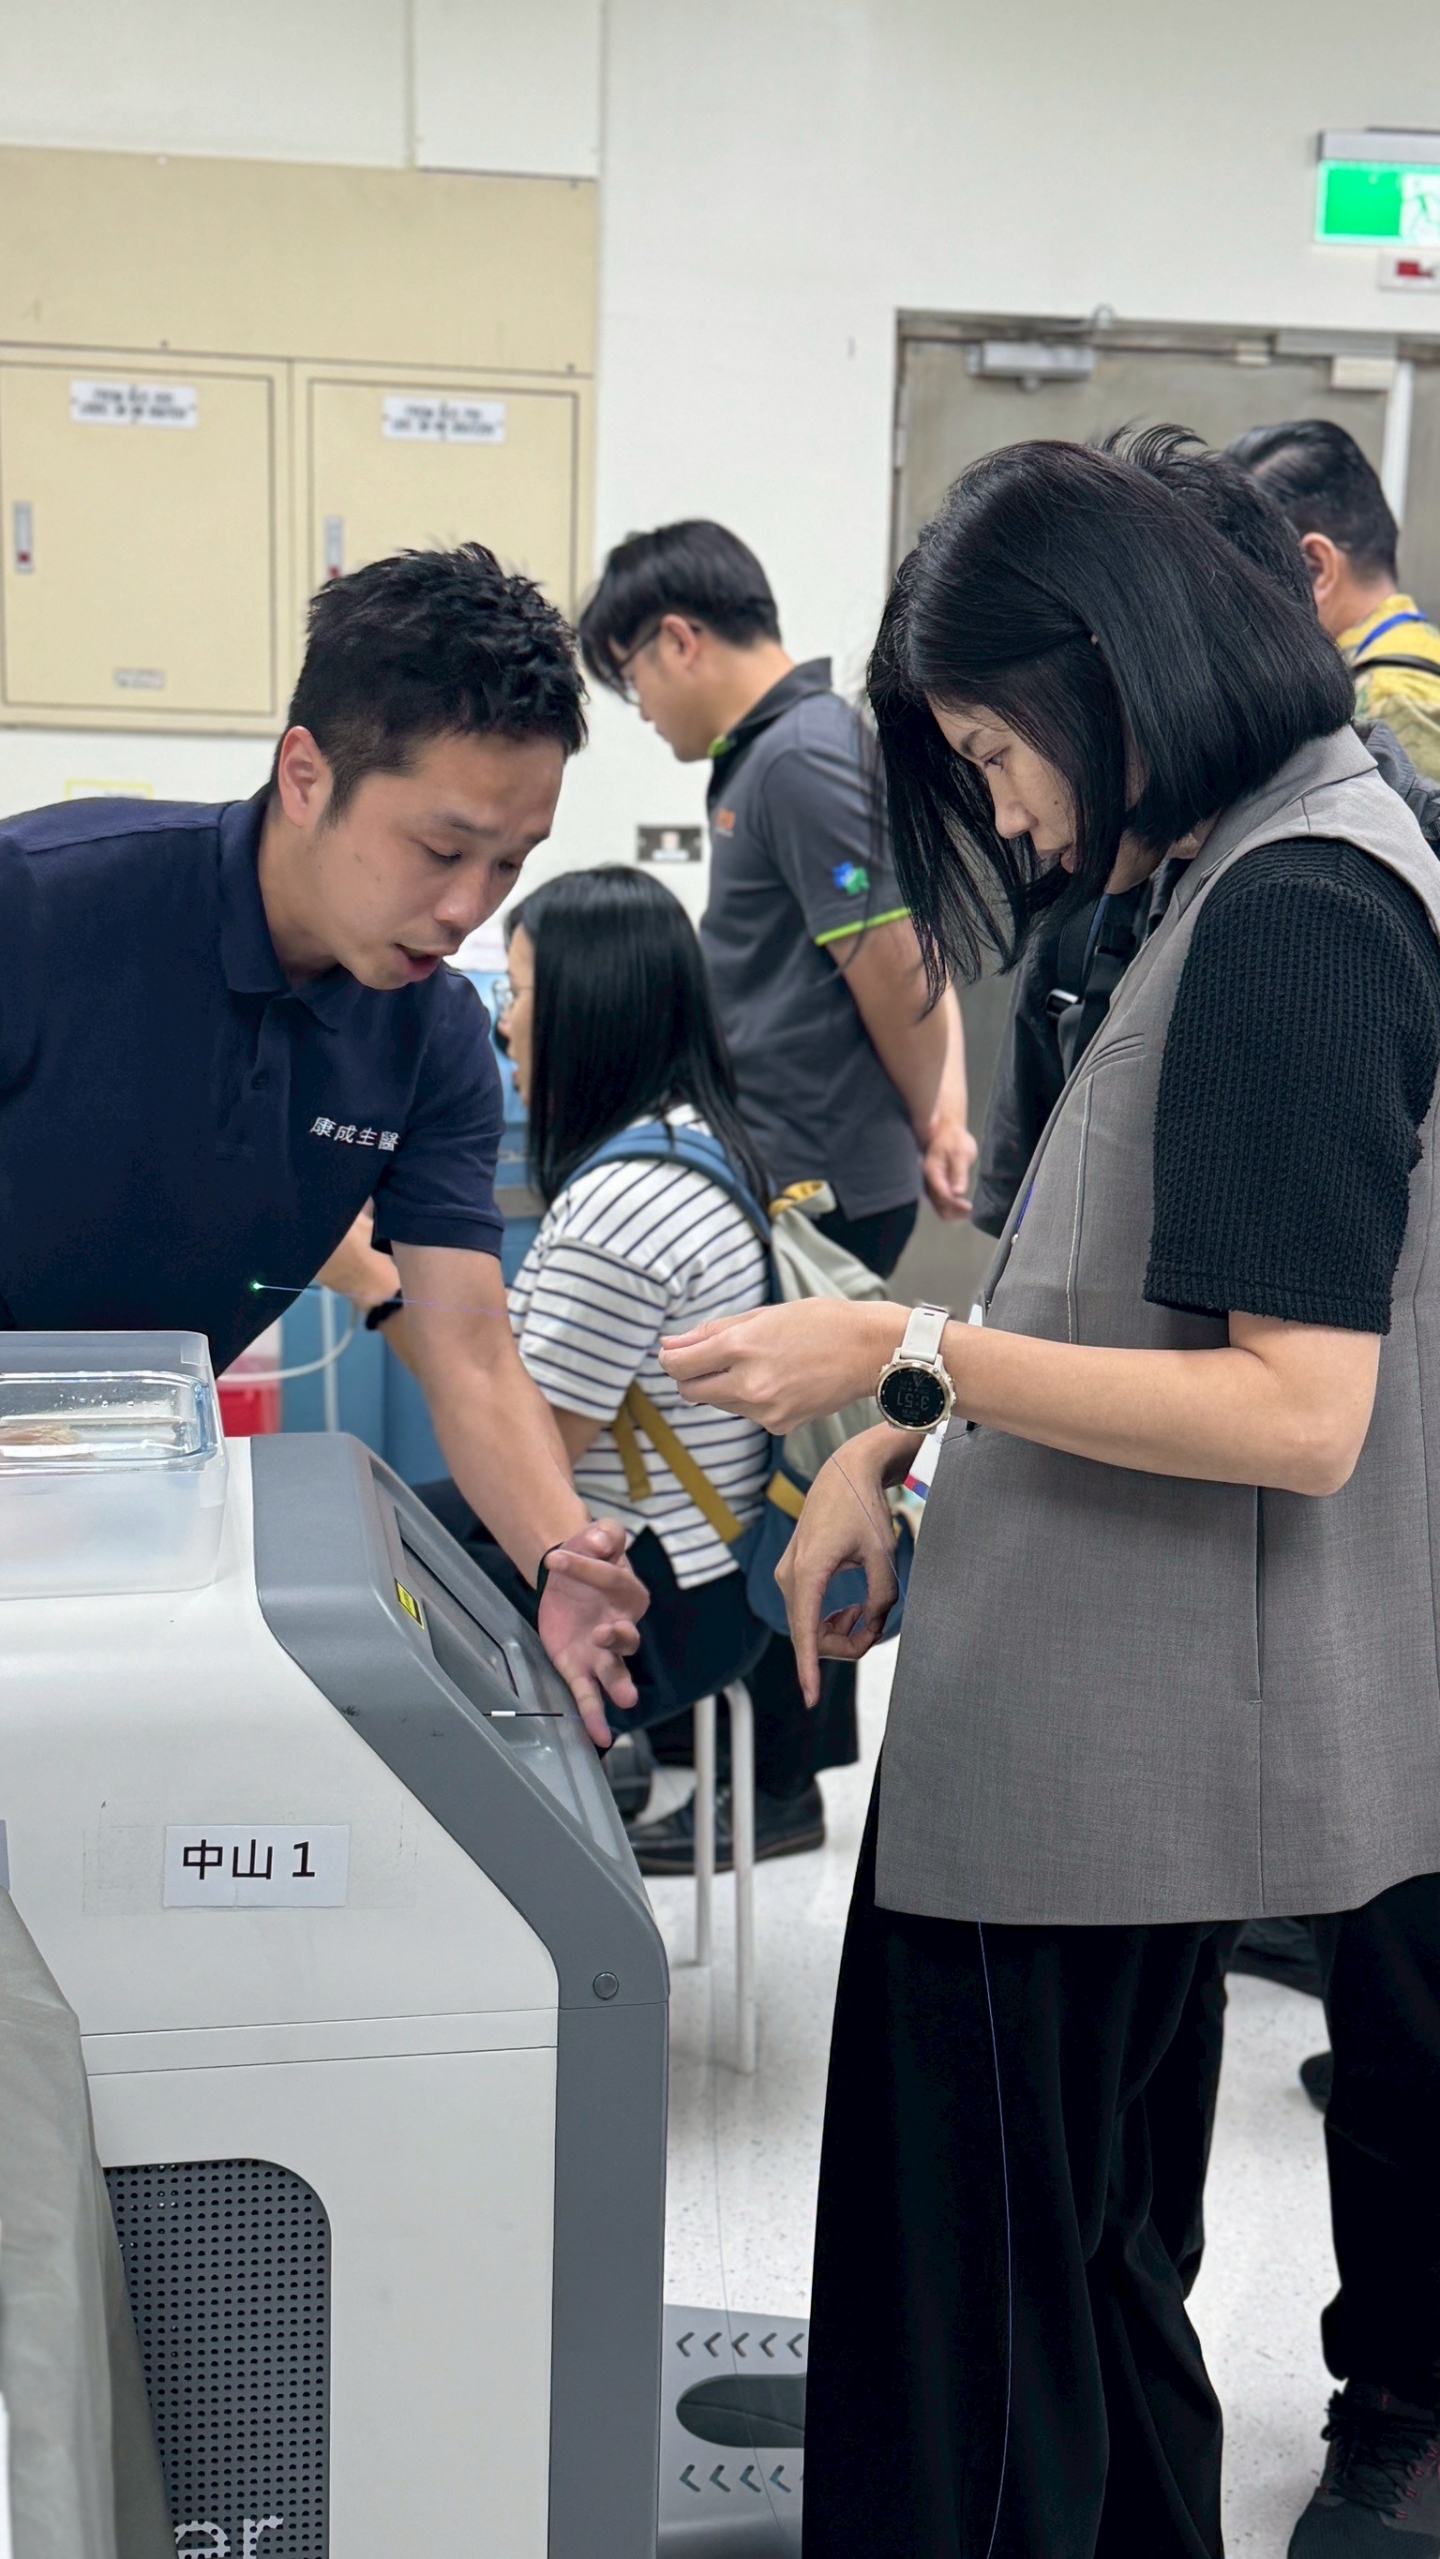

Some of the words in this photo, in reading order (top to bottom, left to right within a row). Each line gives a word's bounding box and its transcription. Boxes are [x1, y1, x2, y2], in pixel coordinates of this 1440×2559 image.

[309, 1116, 401, 1152] 康成生醫
[182, 1839, 274, 1880] 中山
[292, 1841, 316, 1877] 1
